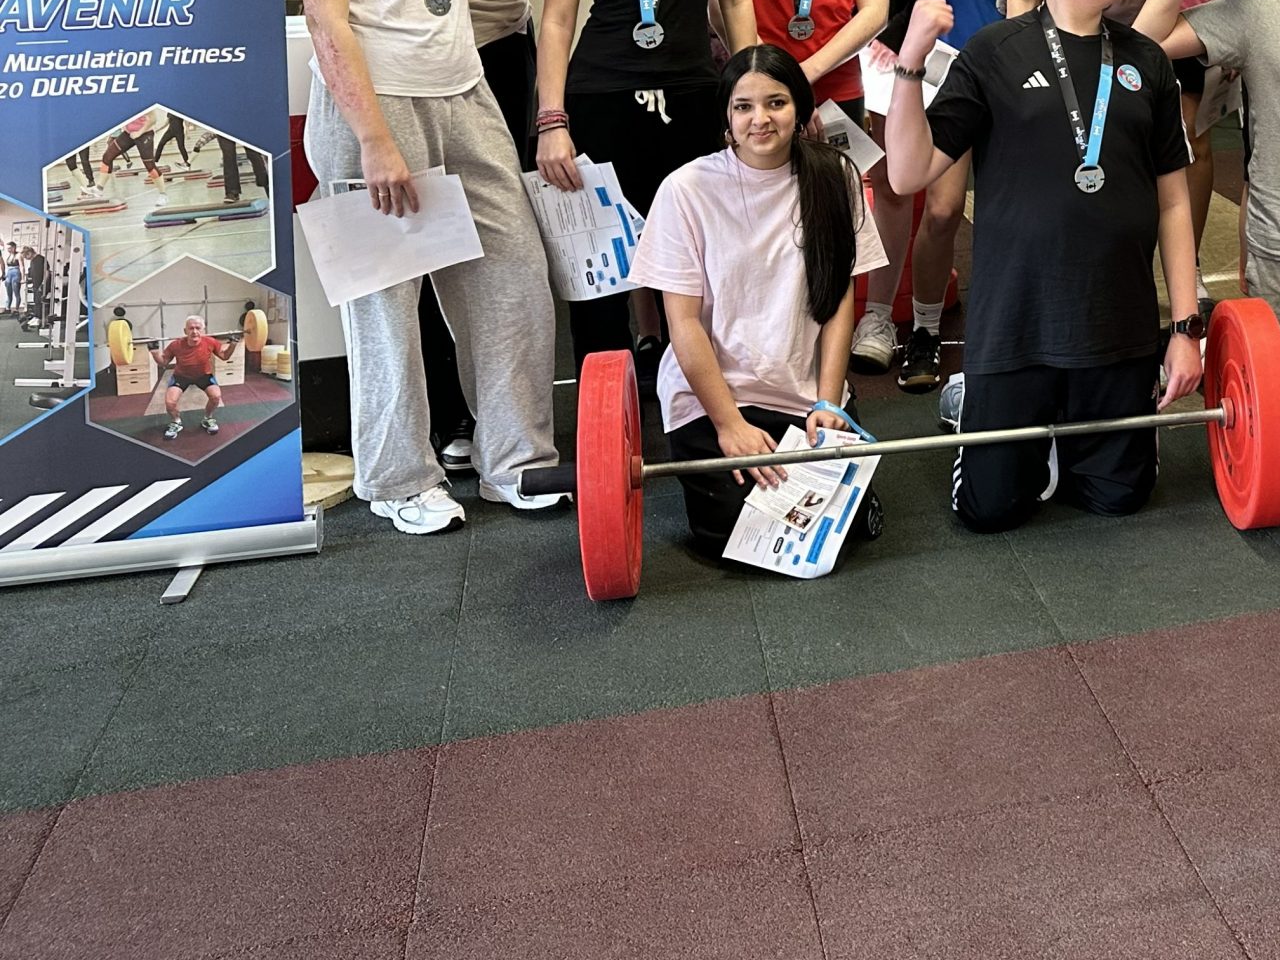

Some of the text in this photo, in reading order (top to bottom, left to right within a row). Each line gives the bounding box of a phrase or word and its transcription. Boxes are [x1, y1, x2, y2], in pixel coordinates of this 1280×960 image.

[3, 46, 246, 73] Musculation Fitness
[31, 74, 140, 98] DURSTEL
